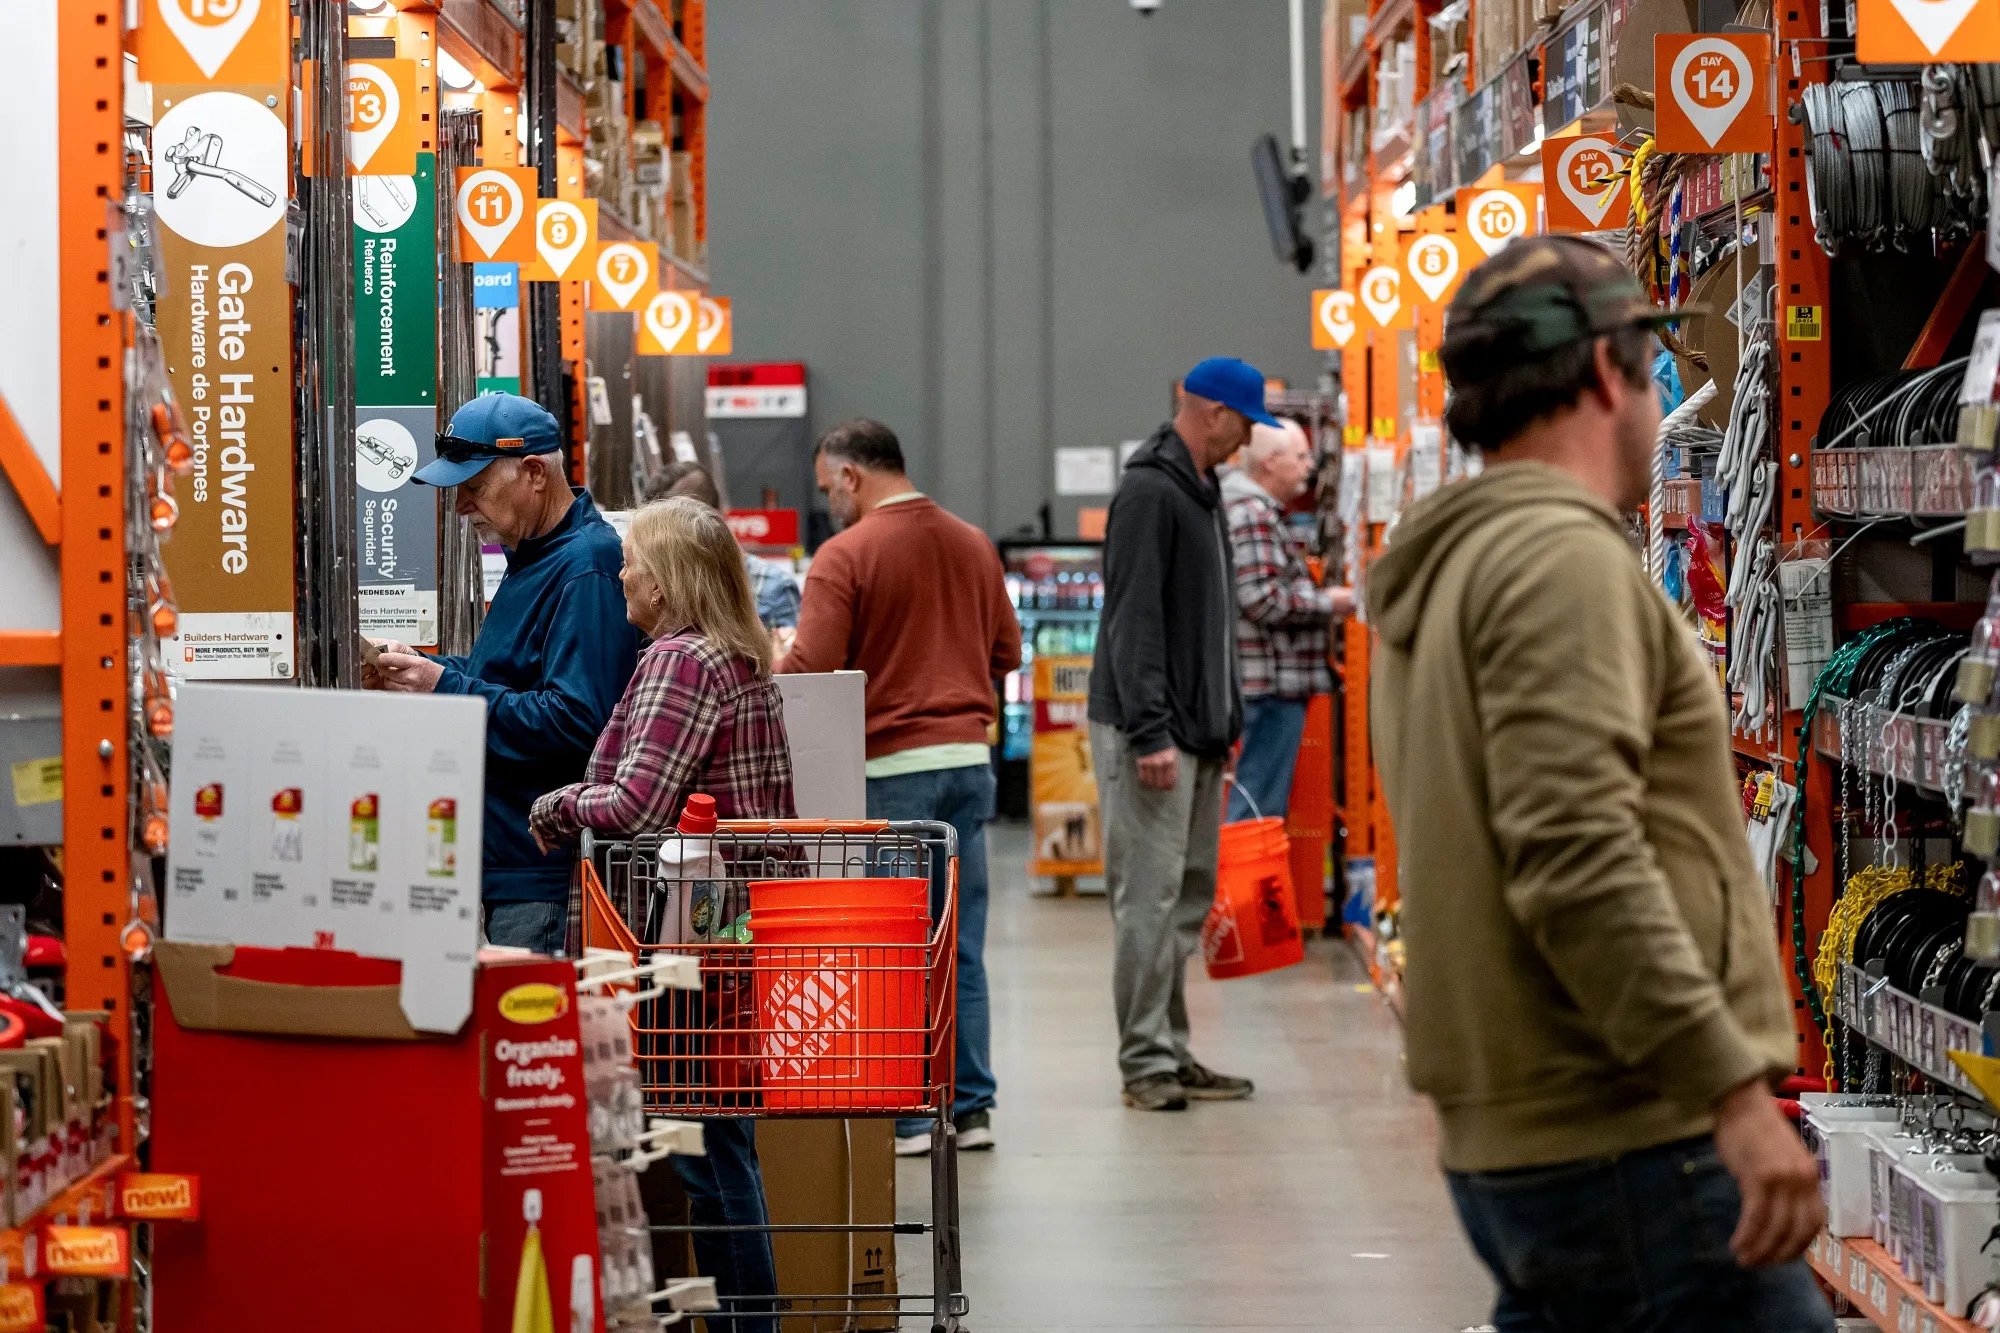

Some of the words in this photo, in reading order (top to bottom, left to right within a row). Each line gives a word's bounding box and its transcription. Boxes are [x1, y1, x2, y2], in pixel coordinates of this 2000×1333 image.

[1700, 56, 1722, 66] BAY
[349, 81, 370, 91] BAY
[1692, 70, 1734, 99] 14
[344, 94, 382, 124] 13
[1580, 153, 1599, 162] BAY
[480, 185, 500, 193] BAY
[1574, 163, 1609, 189] 12
[474, 196, 503, 219] 11
[551, 222, 569, 245] 9
[1481, 211, 1514, 234] 10
[364, 239, 376, 295] Refuerzo
[614, 262, 630, 282] 7
[1425, 253, 1442, 273] 8
[190, 264, 211, 367] Hardware
[217, 261, 254, 361] Gate
[380, 238, 397, 377] Reinforcement
[193, 371, 211, 400] de
[192, 406, 212, 503] Portones
[219, 374, 256, 575] Hardware
[364, 500, 376, 566] Seguridad
[381, 498, 398, 579] Security
[380, 607, 417, 615] Hardware
[184, 633, 222, 642] Builders
[224, 633, 269, 642] Hardware
[764, 970, 800, 1018] THE
[762, 954, 850, 1078] HOME
[495, 1035, 577, 1065] Organize
[788, 999, 857, 1077] DEPOT
[506, 1063, 566, 1090] freely.
[127, 1183, 186, 1209] new!
[52, 1238, 114, 1262] new!
